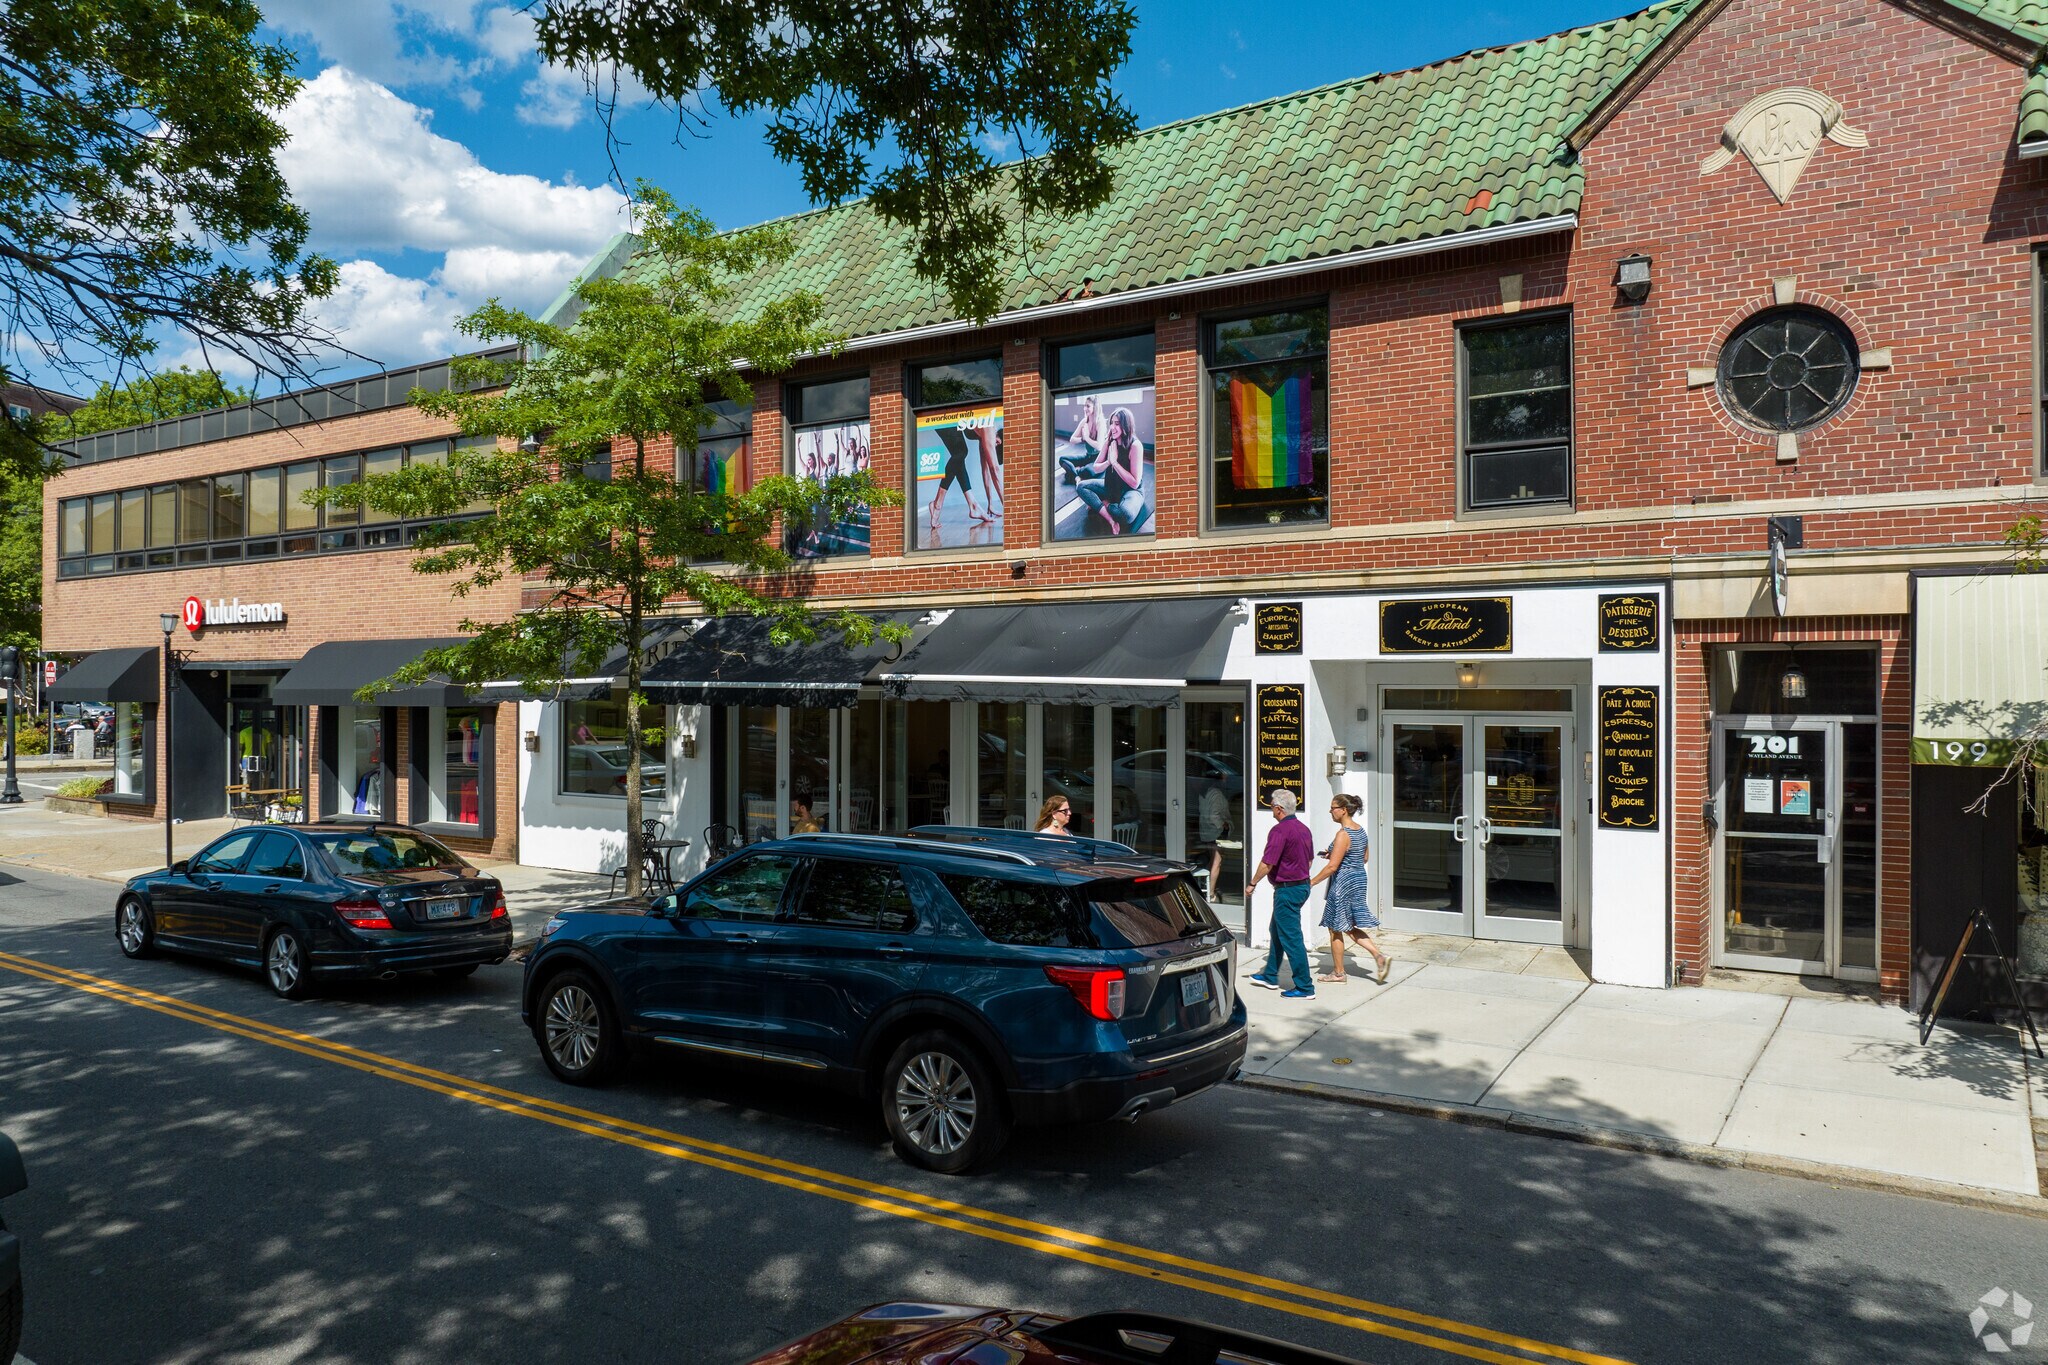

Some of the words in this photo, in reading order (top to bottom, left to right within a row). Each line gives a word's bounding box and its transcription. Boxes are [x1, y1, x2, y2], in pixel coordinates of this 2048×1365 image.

[931, 412, 958, 422] workout
[959, 410, 974, 418] with
[957, 408, 997, 431] soul
[920, 452, 940, 467] $69
[205, 597, 283, 624] lululemon
[1421, 603, 1468, 613] EUROPEAN
[1259, 615, 1299, 625] EUROPEAN
[1412, 617, 1473, 631] Madrid
[1262, 632, 1294, 641] BAKERY
[1405, 629, 1432, 647] BAKERY
[1608, 626, 1649, 638] DESSERTS
[1263, 699, 1298, 707] CROISSANTS
[1631, 699, 1651, 708] CHOUX
[1261, 714, 1299, 724] TARTAS
[1604, 718, 1654, 728] ESPRESSO
[1750, 735, 1799, 754] 201
[1261, 747, 1300, 757] VIENNOISERIE
[1604, 748, 1617, 757] HOT
[1618, 748, 1654, 758] CHOCOLATE
[1930, 741, 1988, 762] 199
[1260, 763, 1273, 771] SAN
[1607, 774, 1649, 786] COOKIES
[1610, 794, 1645, 808] BRIOCHE
